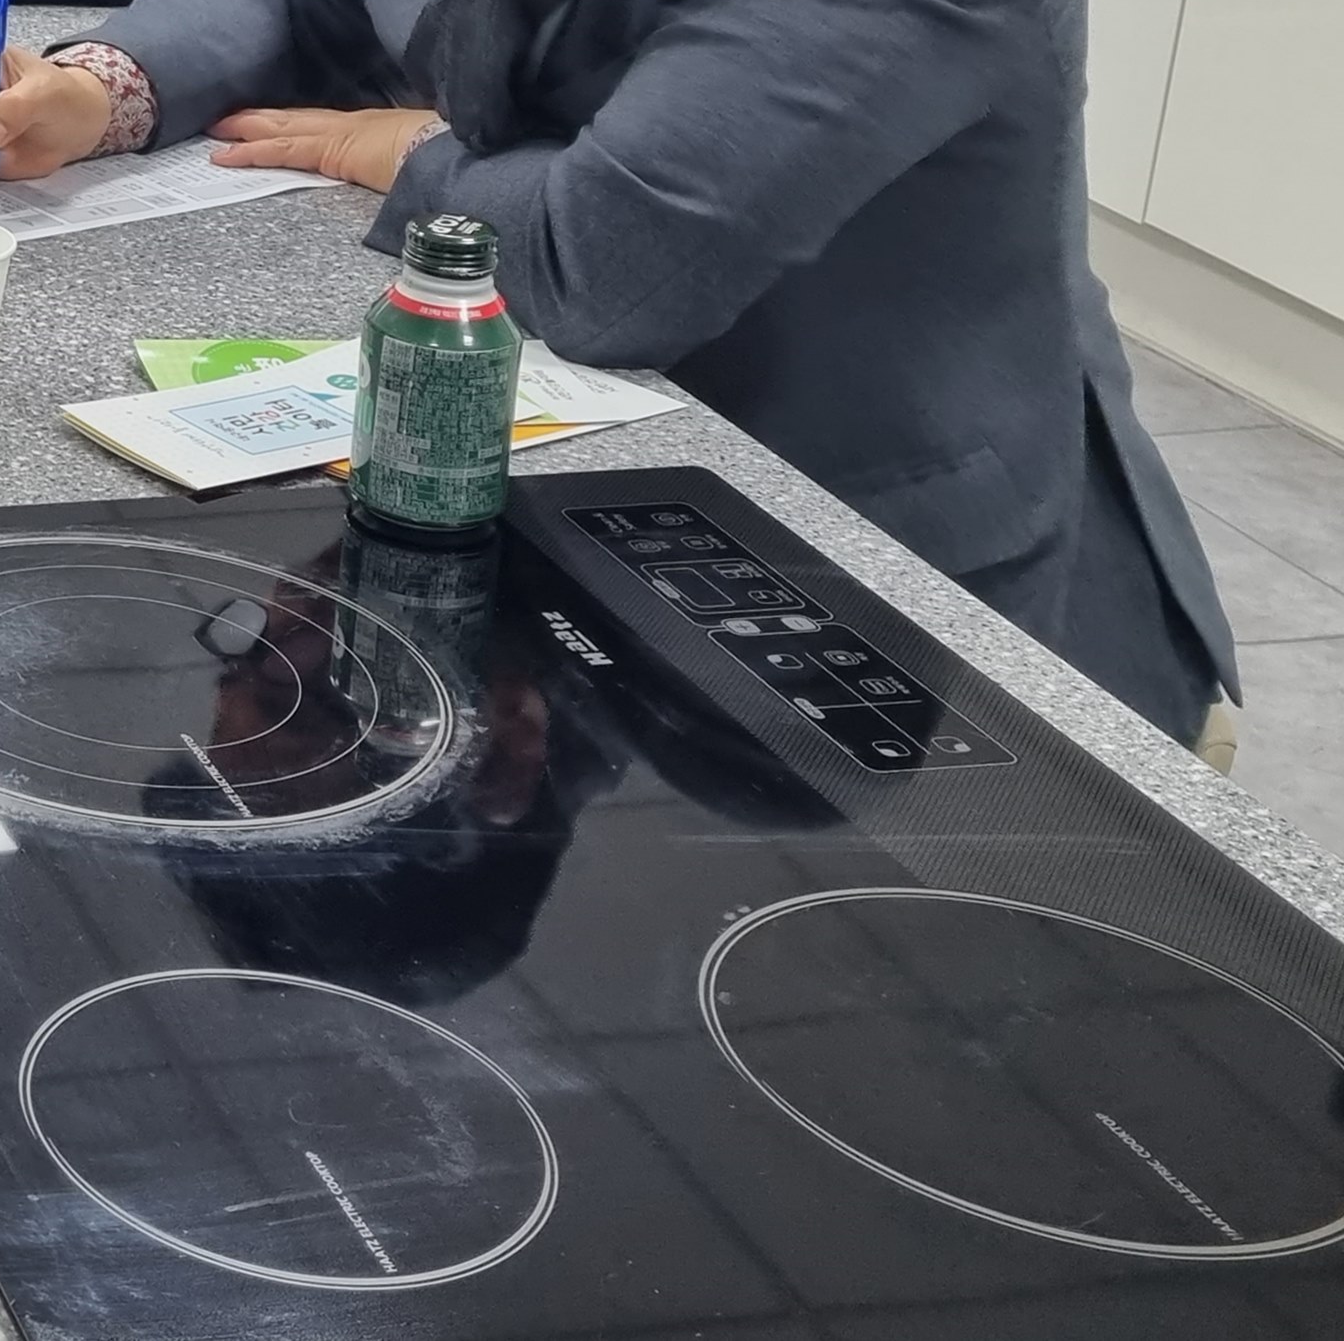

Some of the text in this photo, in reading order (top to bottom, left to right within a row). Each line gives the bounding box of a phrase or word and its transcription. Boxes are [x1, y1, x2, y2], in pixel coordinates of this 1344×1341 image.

[222, 415, 274, 438] 시민
[250, 409, 300, 432] 건강
[540, 610, 615, 668] Haatz
[1094, 1111, 1151, 1159] COOKTOP
[1146, 1160, 1206, 1206] ELECTRIC
[305, 1151, 398, 1273] HAATZ ELECTRIC COOKTOP
